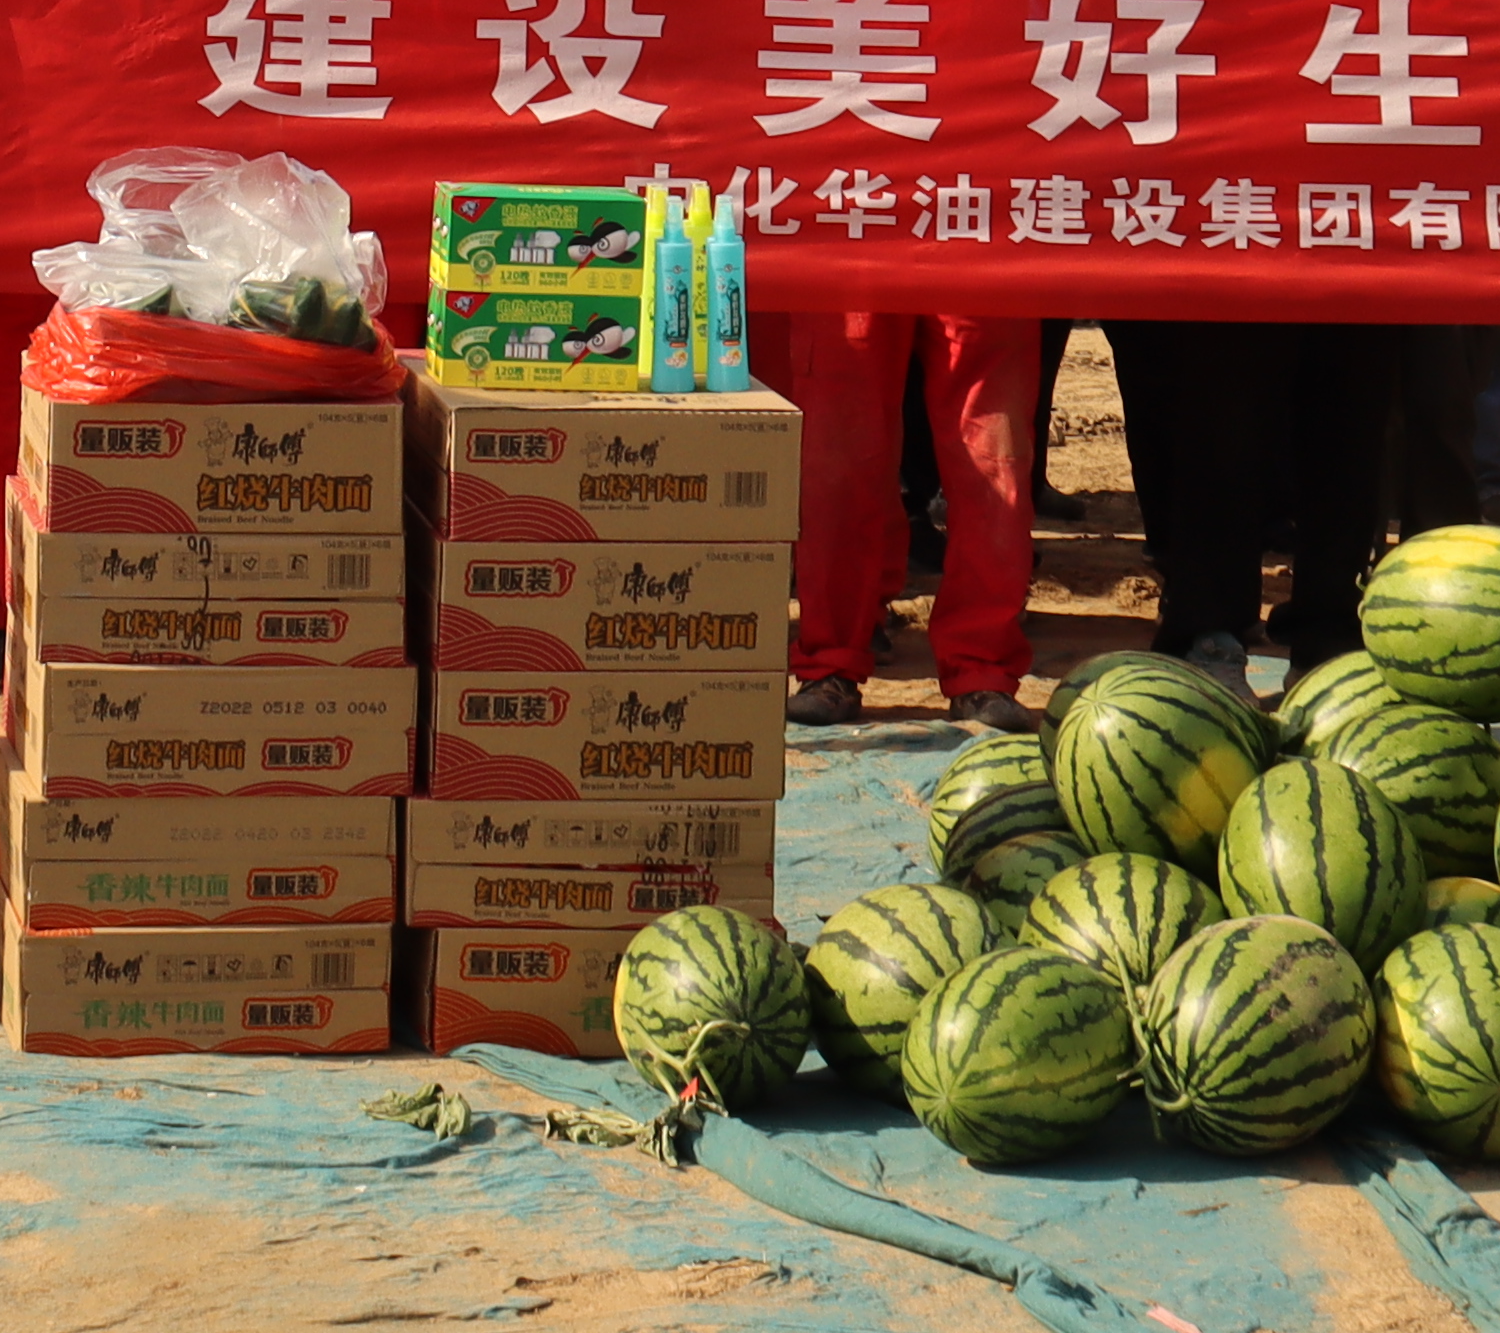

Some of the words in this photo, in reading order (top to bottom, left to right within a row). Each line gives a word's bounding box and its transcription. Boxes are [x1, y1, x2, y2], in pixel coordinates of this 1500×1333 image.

[79, 427, 162, 453] 量贩装
[474, 434, 548, 459] 量贩装
[197, 474, 372, 512] 红烧牛肉面
[579, 473, 708, 503] 红烧牛肉面
[470, 566, 552, 592] 量贩装
[263, 617, 330, 638] 量贩装
[585, 612, 758, 650] 红烧牛肉面
[200, 701, 252, 714] Z2022
[263, 701, 304, 714] 0512
[316, 701, 336, 714] 03
[347, 701, 387, 714] 0040
[465, 695, 547, 721] 量贩装
[106, 739, 246, 770] 红烧牛肉面
[268, 743, 336, 765] 量贩装
[580, 740, 753, 779] 红烧牛肉面
[77, 873, 229, 904] 香辣牛肉面
[252, 874, 318, 896] 量贩装
[474, 876, 613, 911] 红烧牛肉面
[470, 950, 549, 976] 量贩装
[74, 999, 224, 1030] 香辣牛肉面
[248, 1003, 316, 1025] 量贩装
